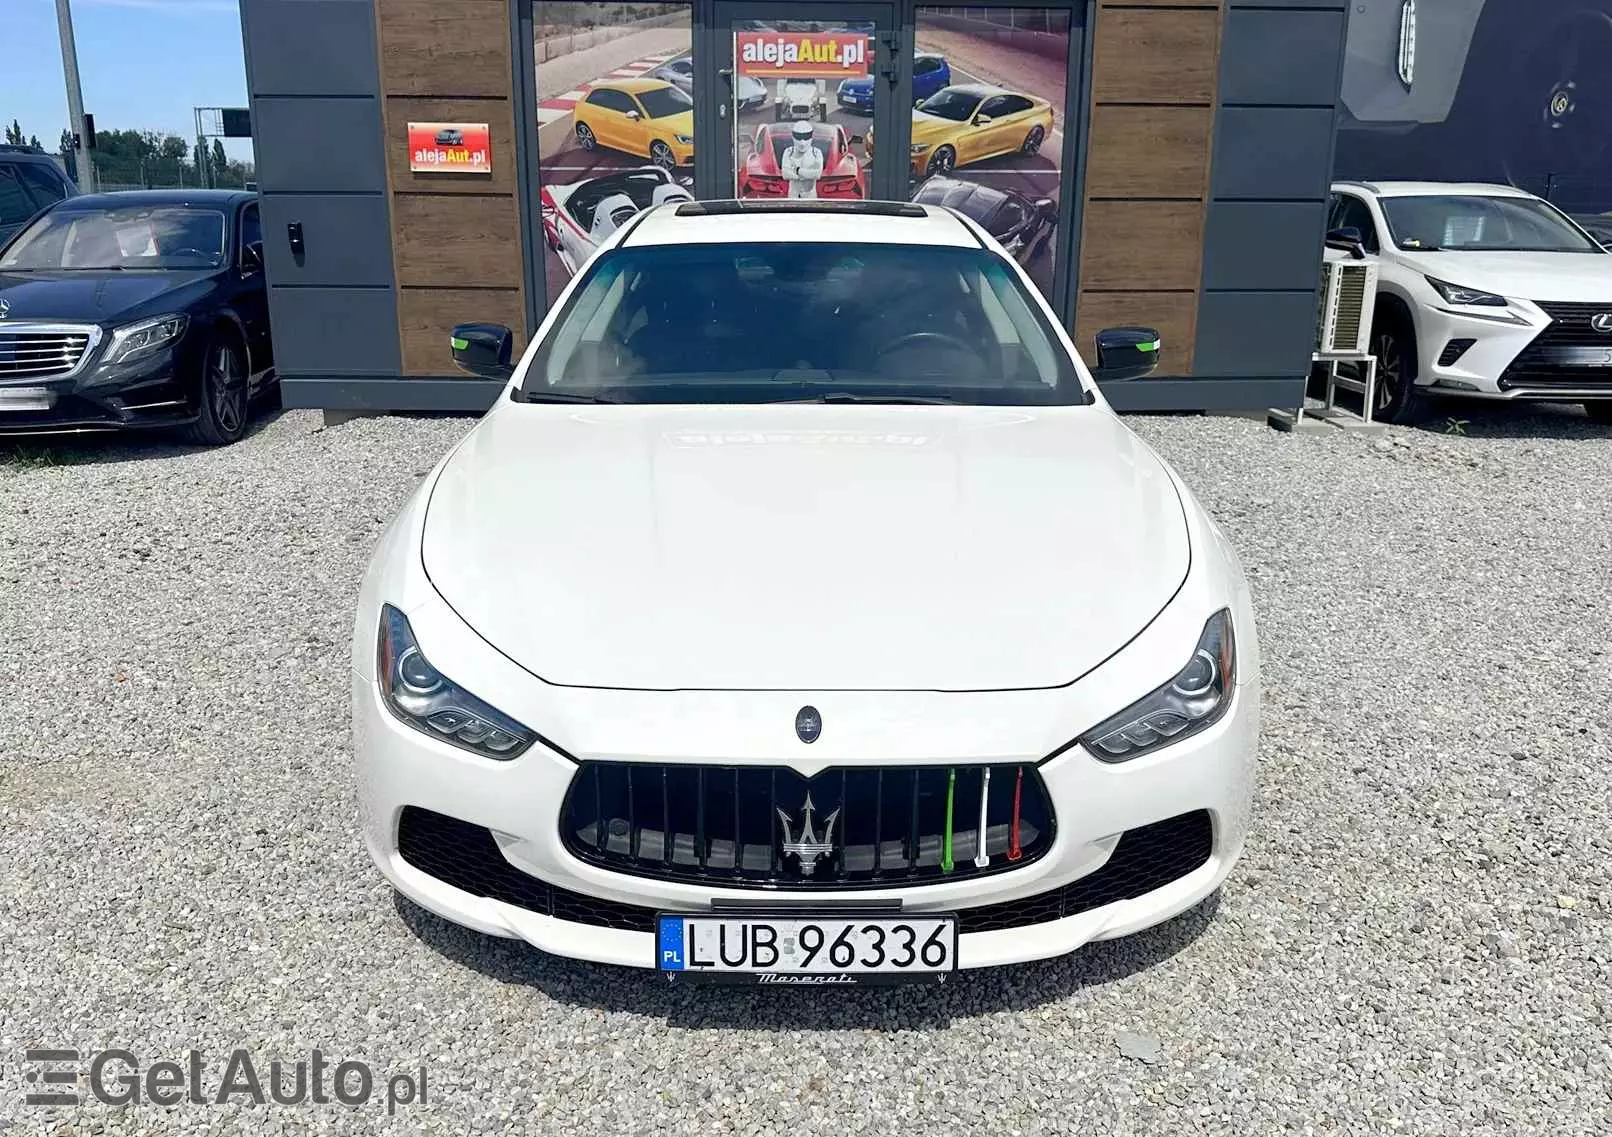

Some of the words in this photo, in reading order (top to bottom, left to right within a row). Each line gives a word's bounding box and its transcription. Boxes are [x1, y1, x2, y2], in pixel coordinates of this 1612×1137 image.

[742, 39, 865, 67] alejaAut.pl
[415, 148, 486, 165] alejaAut.pl
[689, 924, 779, 968] LUB
[798, 924, 947, 968] 96336
[664, 951, 681, 963] PL
[756, 972, 858, 985] Maserati
